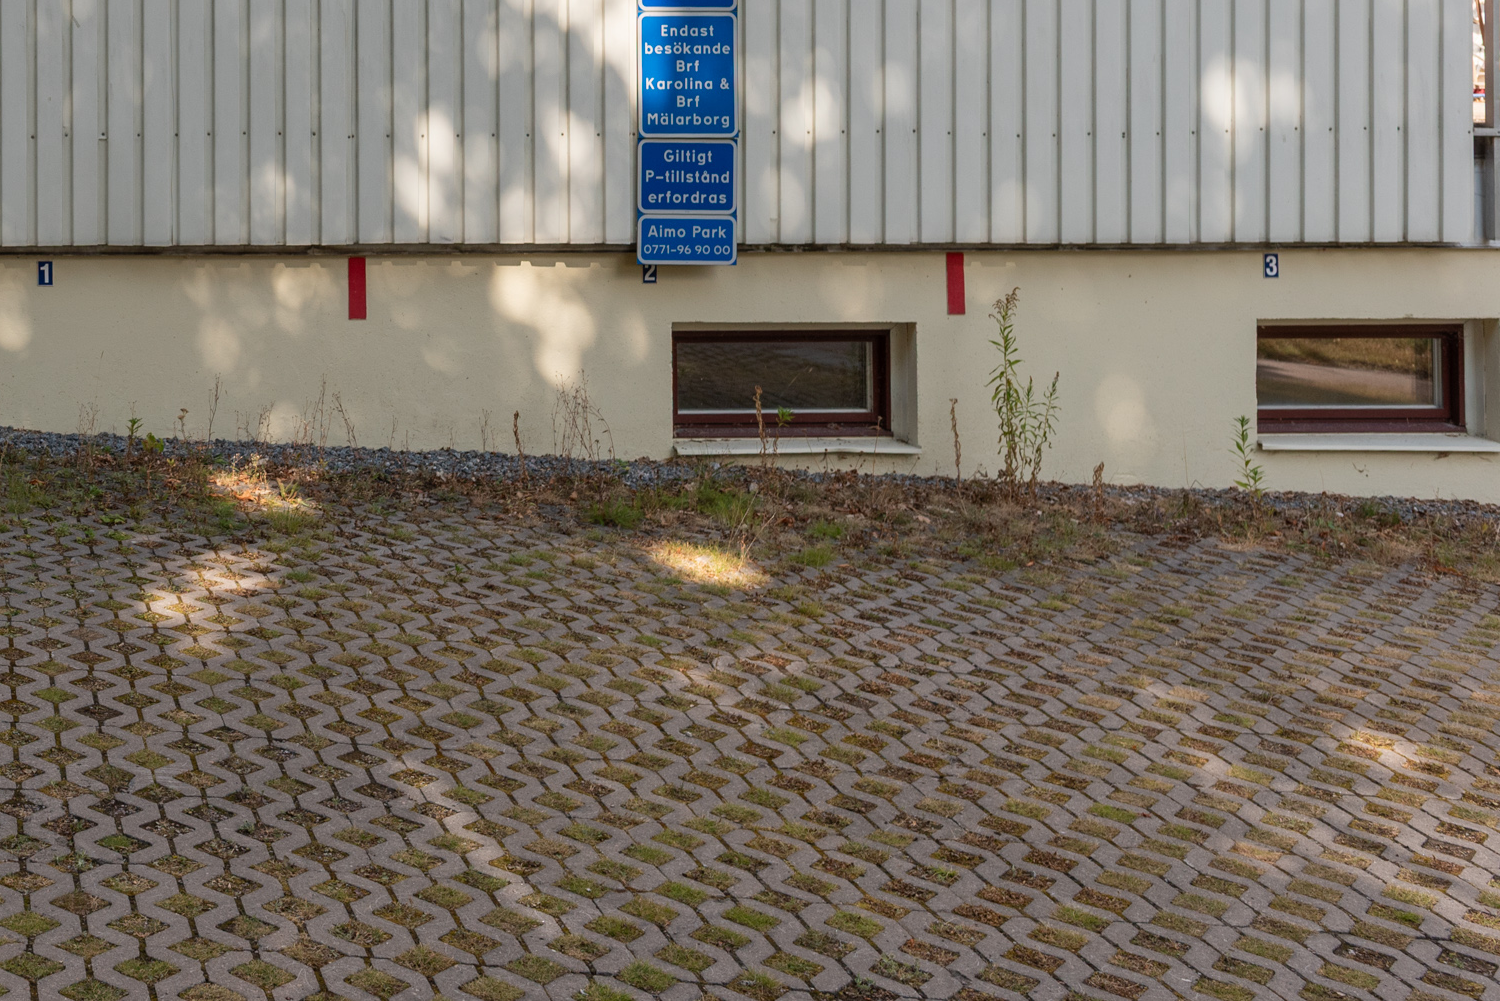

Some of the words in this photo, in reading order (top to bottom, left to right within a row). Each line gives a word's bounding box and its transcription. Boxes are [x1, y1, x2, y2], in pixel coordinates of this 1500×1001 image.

[660, 24, 715, 37] Endast
[644, 42, 731, 55] besökande
[676, 60, 700, 72] Brf
[645, 77, 713, 90] Karolina
[720, 77, 730, 90] &
[676, 95, 700, 108] Brf
[647, 113, 730, 128] Mälarborg
[663, 149, 713, 166] Giltigt
[645, 170, 730, 184] P-tillstånd
[648, 190, 727, 204] erfordras
[647, 225, 686, 238] Aimo
[692, 225, 727, 239] Park
[643, 244, 692, 255] 0771-96
[694, 244, 711, 255] 90
[713, 244, 731, 255] 00
[644, 264, 656, 281] 2
[1265, 255, 1278, 276] 3
[39, 263, 49, 284] 1
